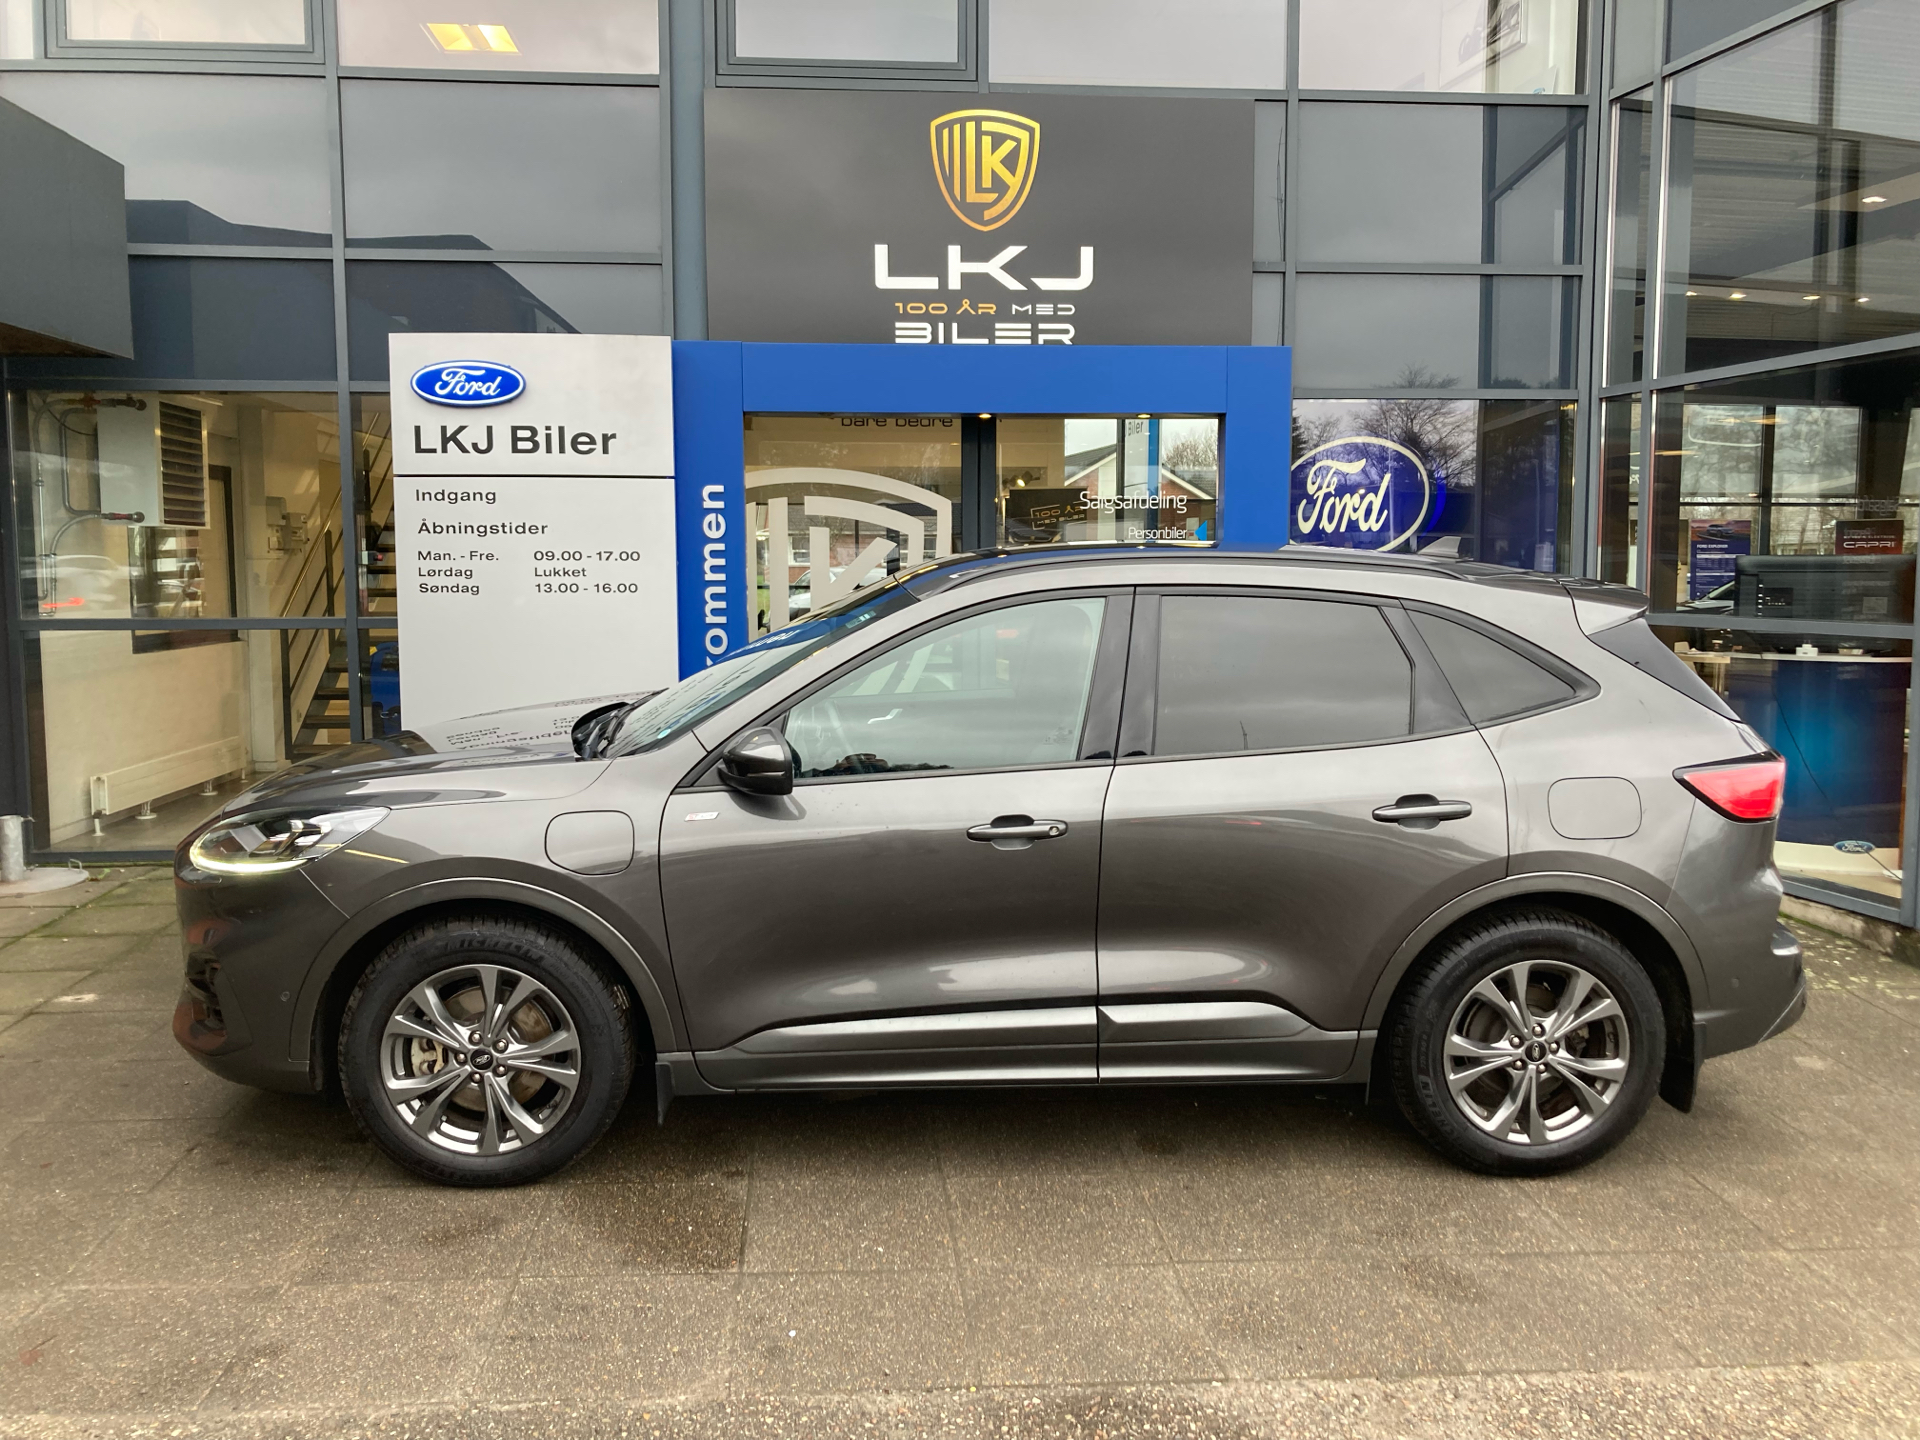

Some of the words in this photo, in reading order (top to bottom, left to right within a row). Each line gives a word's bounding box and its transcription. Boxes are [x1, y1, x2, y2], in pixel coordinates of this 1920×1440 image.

[875, 244, 1094, 290] LKJ
[895, 302, 948, 314] 100
[956, 299, 997, 315] ÅR
[1012, 304, 1076, 315] MED
[895, 322, 1076, 345] BILER
[434, 367, 503, 397] Ford
[414, 425, 494, 455] LKJ
[510, 425, 617, 455] Biler
[415, 488, 497, 504] Indgang
[1080, 491, 1188, 514] Salgsafdeling
[1297, 458, 1391, 534] Ford
[418, 518, 549, 537] Åbningstider
[1128, 527, 1187, 539] Personbiler
[1843, 541, 1895, 549] CAPRI
[418, 550, 456, 561] Man.
[469, 550, 499, 561] Fre.
[533, 550, 583, 562] 09.00
[596, 550, 641, 562] 17.00
[418, 566, 474, 579] Lørdag
[534, 566, 587, 577] Lukket
[702, 484, 729, 667] ommen
[419, 583, 480, 596] Søndag
[534, 583, 579, 594] 13.00
[594, 583, 638, 594] 16.00
